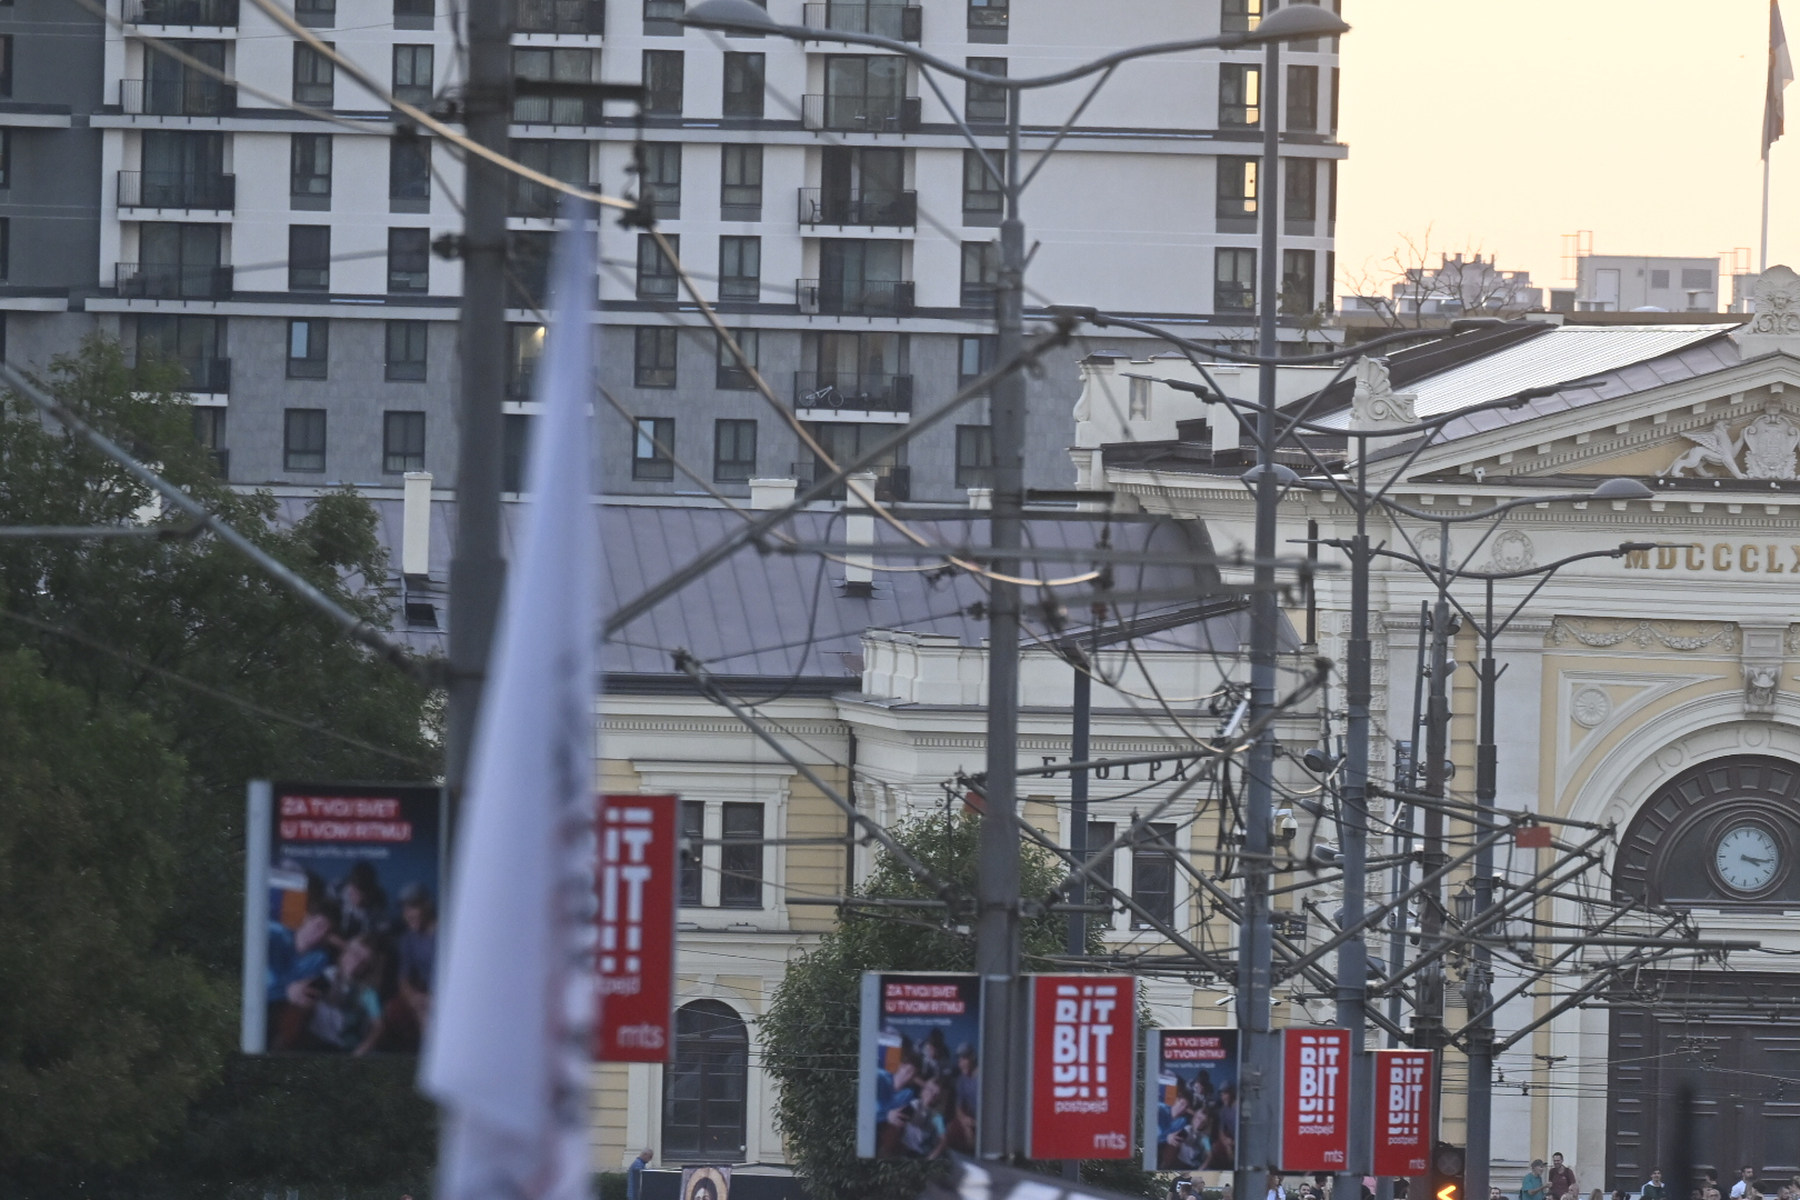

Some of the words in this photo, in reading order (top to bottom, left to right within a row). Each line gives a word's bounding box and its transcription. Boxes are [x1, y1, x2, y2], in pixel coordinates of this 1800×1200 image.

[616, 1022, 664, 1048] mts
[1055, 1100, 1108, 1114] postpejd
[1298, 1124, 1335, 1136] postpejd
[1093, 1130, 1127, 1149] mts
[1324, 1148, 1344, 1163] mts
[1409, 1157, 1426, 1169] mts
